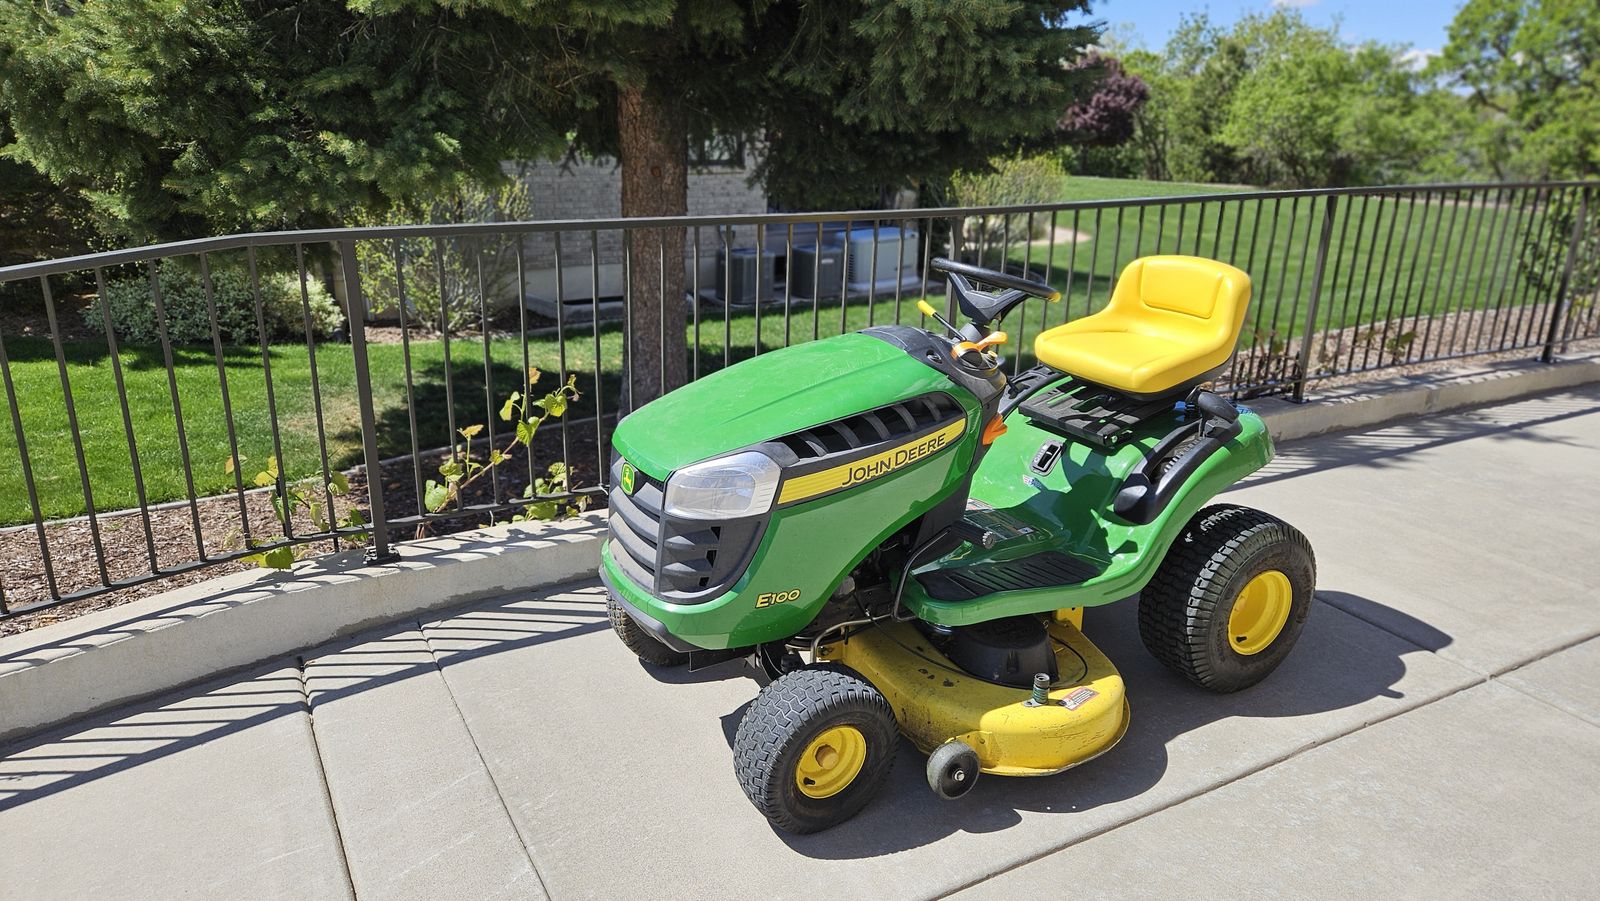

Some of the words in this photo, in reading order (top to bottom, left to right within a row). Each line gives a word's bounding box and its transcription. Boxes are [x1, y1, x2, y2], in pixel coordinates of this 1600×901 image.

[842, 457, 891, 486] JOHN
[895, 433, 946, 467] DEERE
[755, 588, 801, 609] E100
